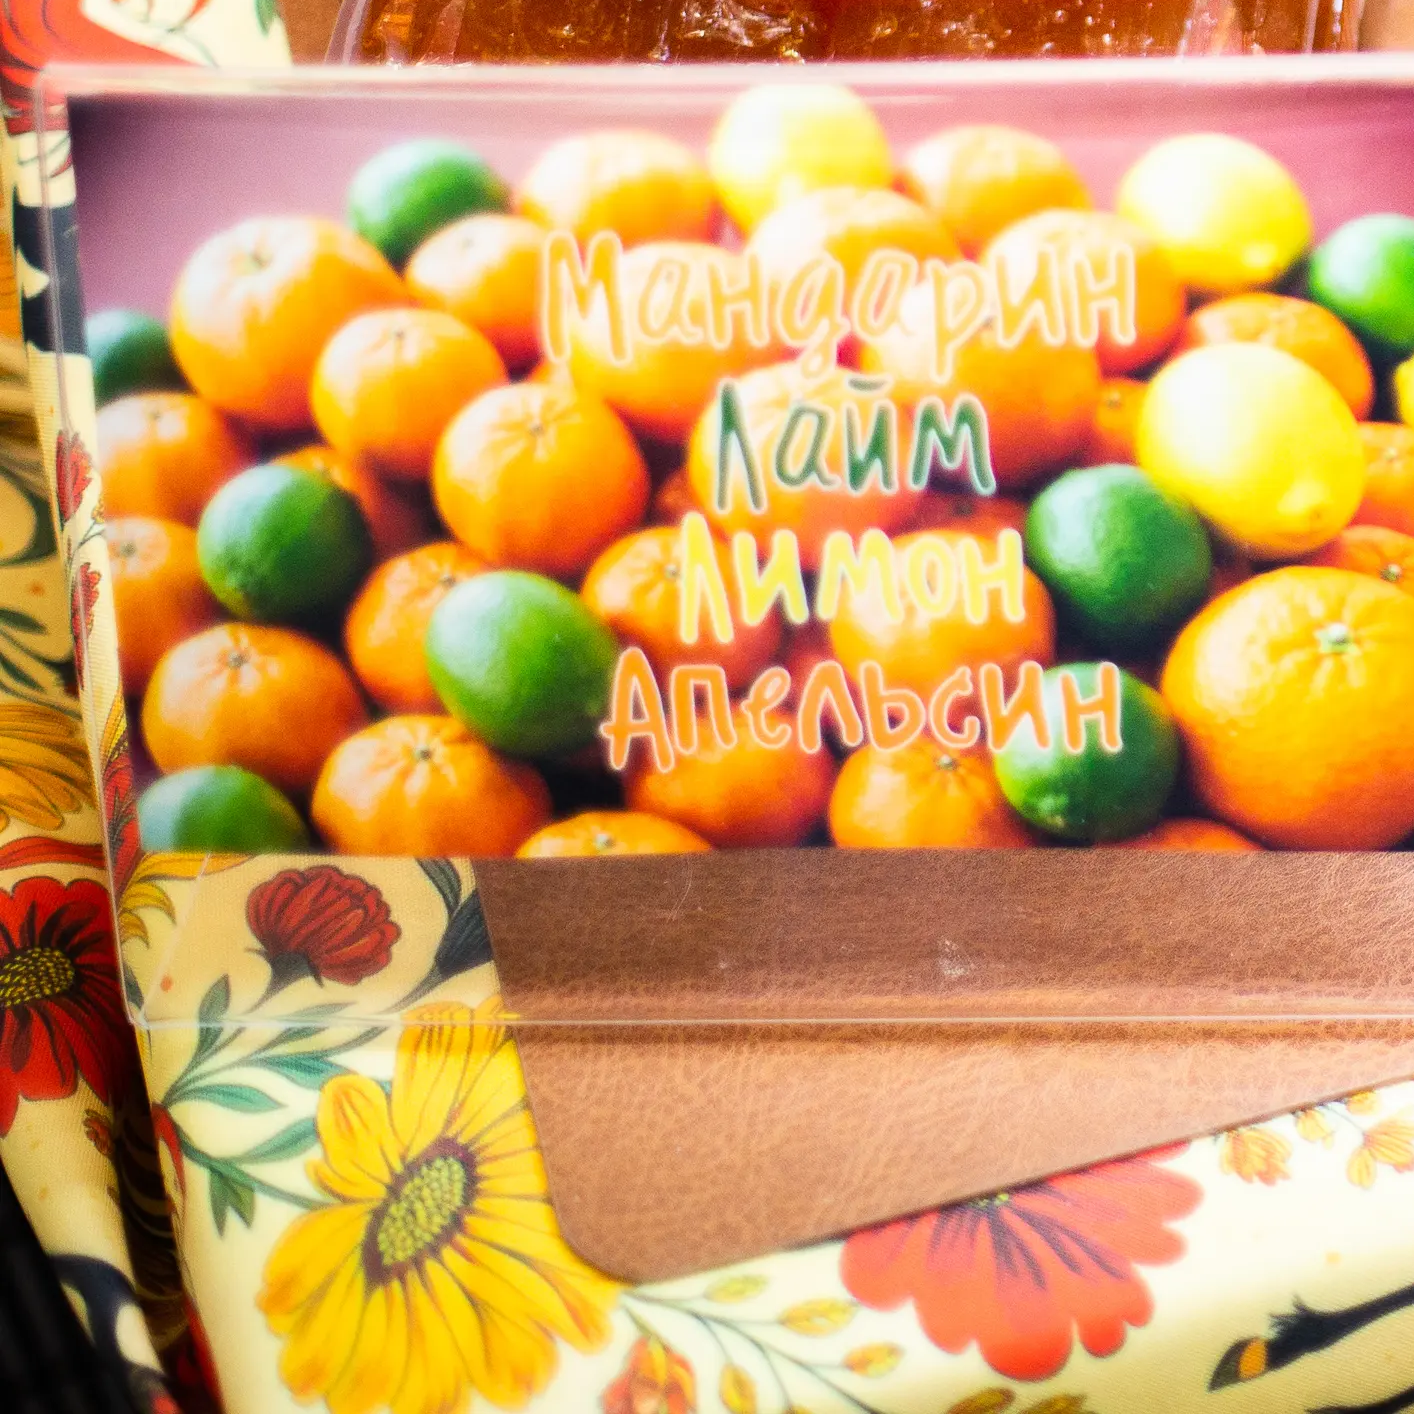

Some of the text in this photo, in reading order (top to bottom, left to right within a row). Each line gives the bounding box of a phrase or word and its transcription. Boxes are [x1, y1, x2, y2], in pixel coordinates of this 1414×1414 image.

[540, 229, 1138, 384] Мандарин
[714, 377, 997, 513] Лайм
[679, 512, 1025, 644] Лимон
[600, 646, 1124, 772] Апельсин
